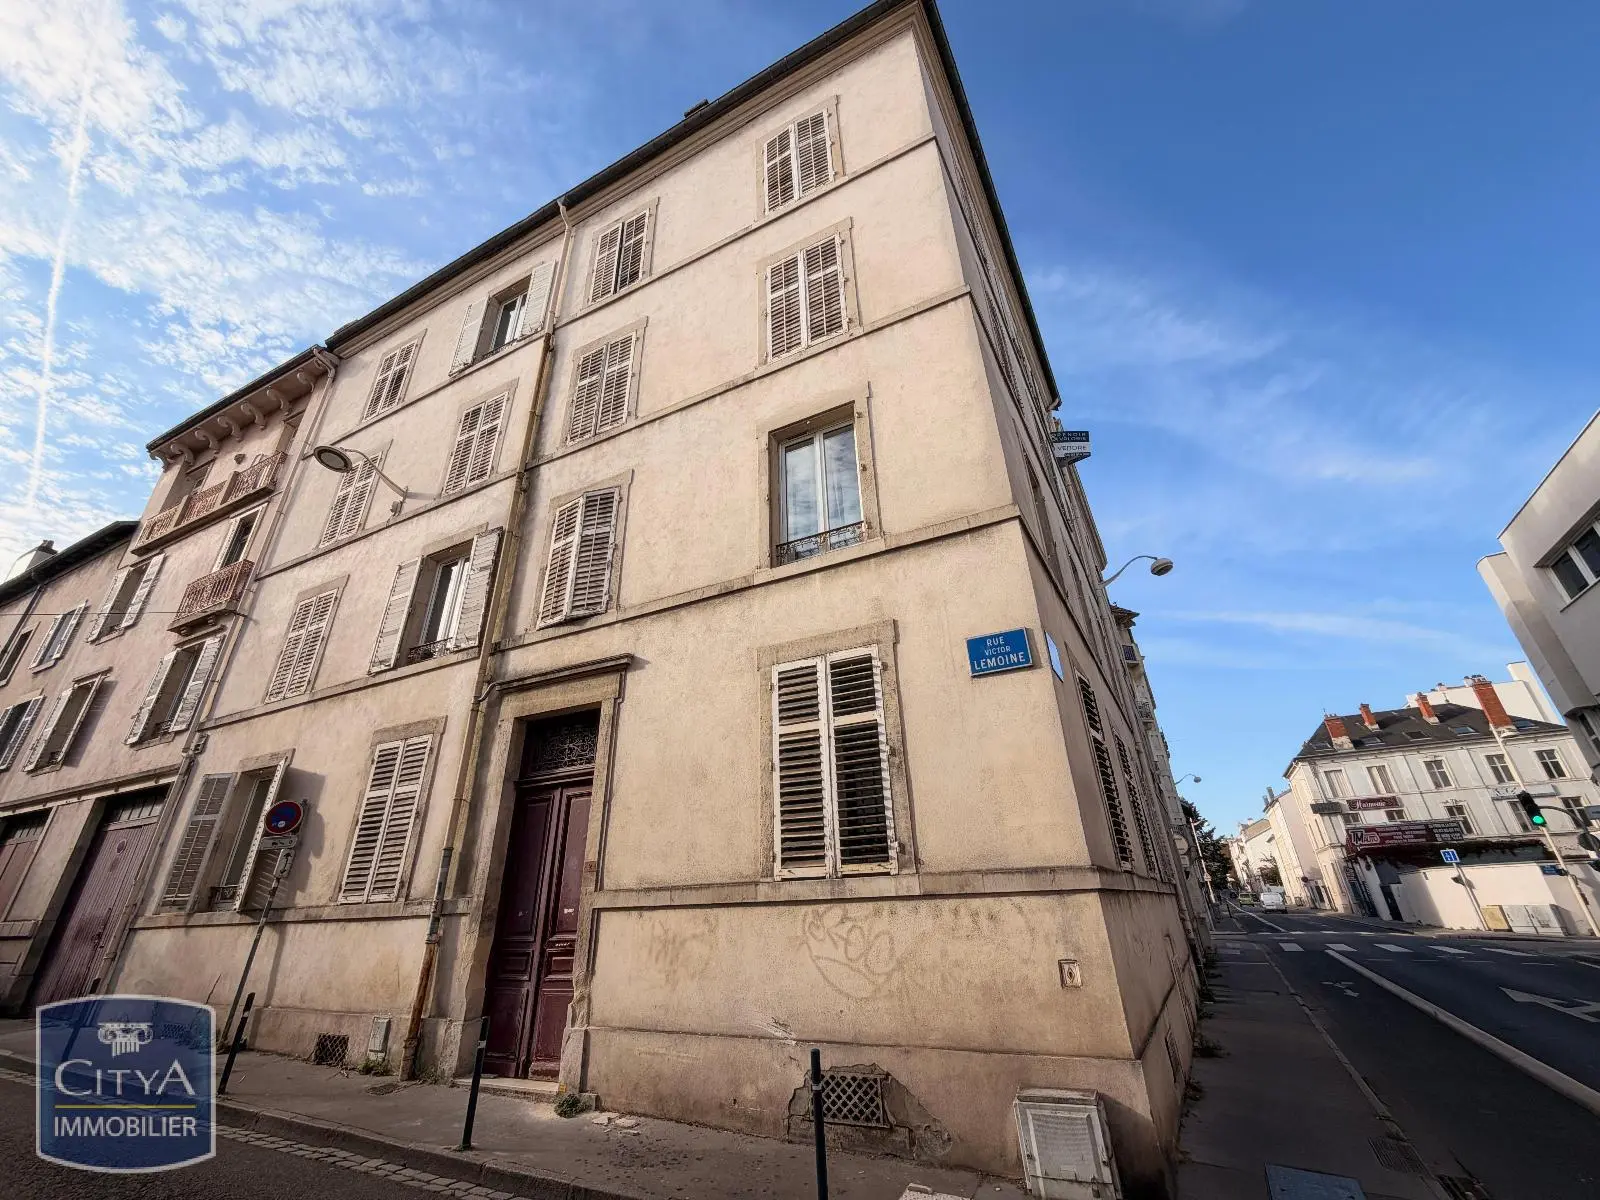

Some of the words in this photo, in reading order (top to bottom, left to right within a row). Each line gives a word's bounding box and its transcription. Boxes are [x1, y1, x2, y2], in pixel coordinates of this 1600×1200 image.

[986, 636, 1005, 647] RUE
[984, 645, 1011, 656] VICTOR
[973, 651, 1026, 670] LEMOINE
